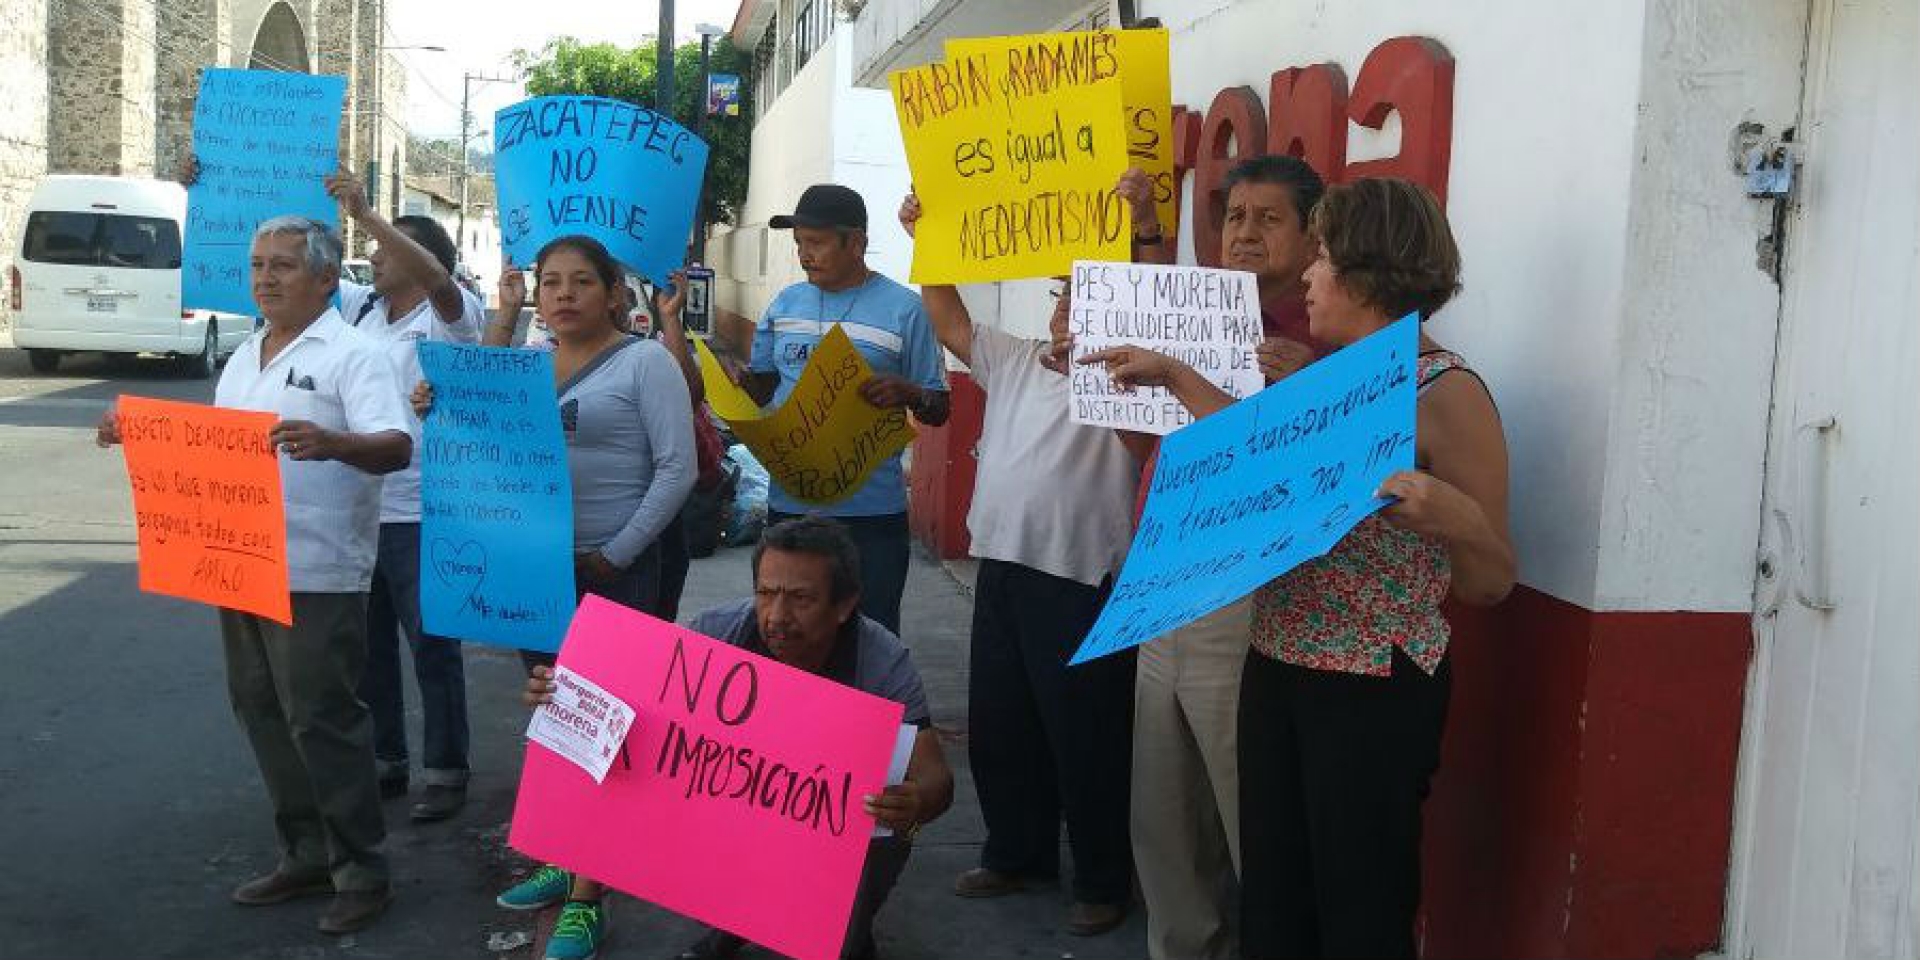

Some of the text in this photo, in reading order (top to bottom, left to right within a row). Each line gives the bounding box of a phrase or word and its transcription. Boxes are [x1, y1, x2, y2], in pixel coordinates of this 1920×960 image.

[900, 54, 992, 129] RABIN
[499, 99, 690, 164] ZACATEPEC
[1006, 110, 1068, 184] igual
[550, 147, 598, 186] NO
[547, 195, 648, 242] VENDE
[959, 187, 1123, 262] NEOPOTISMO
[1076, 266, 1248, 312] PES Y MORENA
[1073, 308, 1263, 346] SE COLUDIERON PARA
[1230, 346, 1253, 370] DE
[1078, 399, 1156, 426] DISTRITO
[658, 637, 760, 727] NO
[545, 702, 599, 738] morena
[656, 721, 852, 837] IMPOSICIÓN
